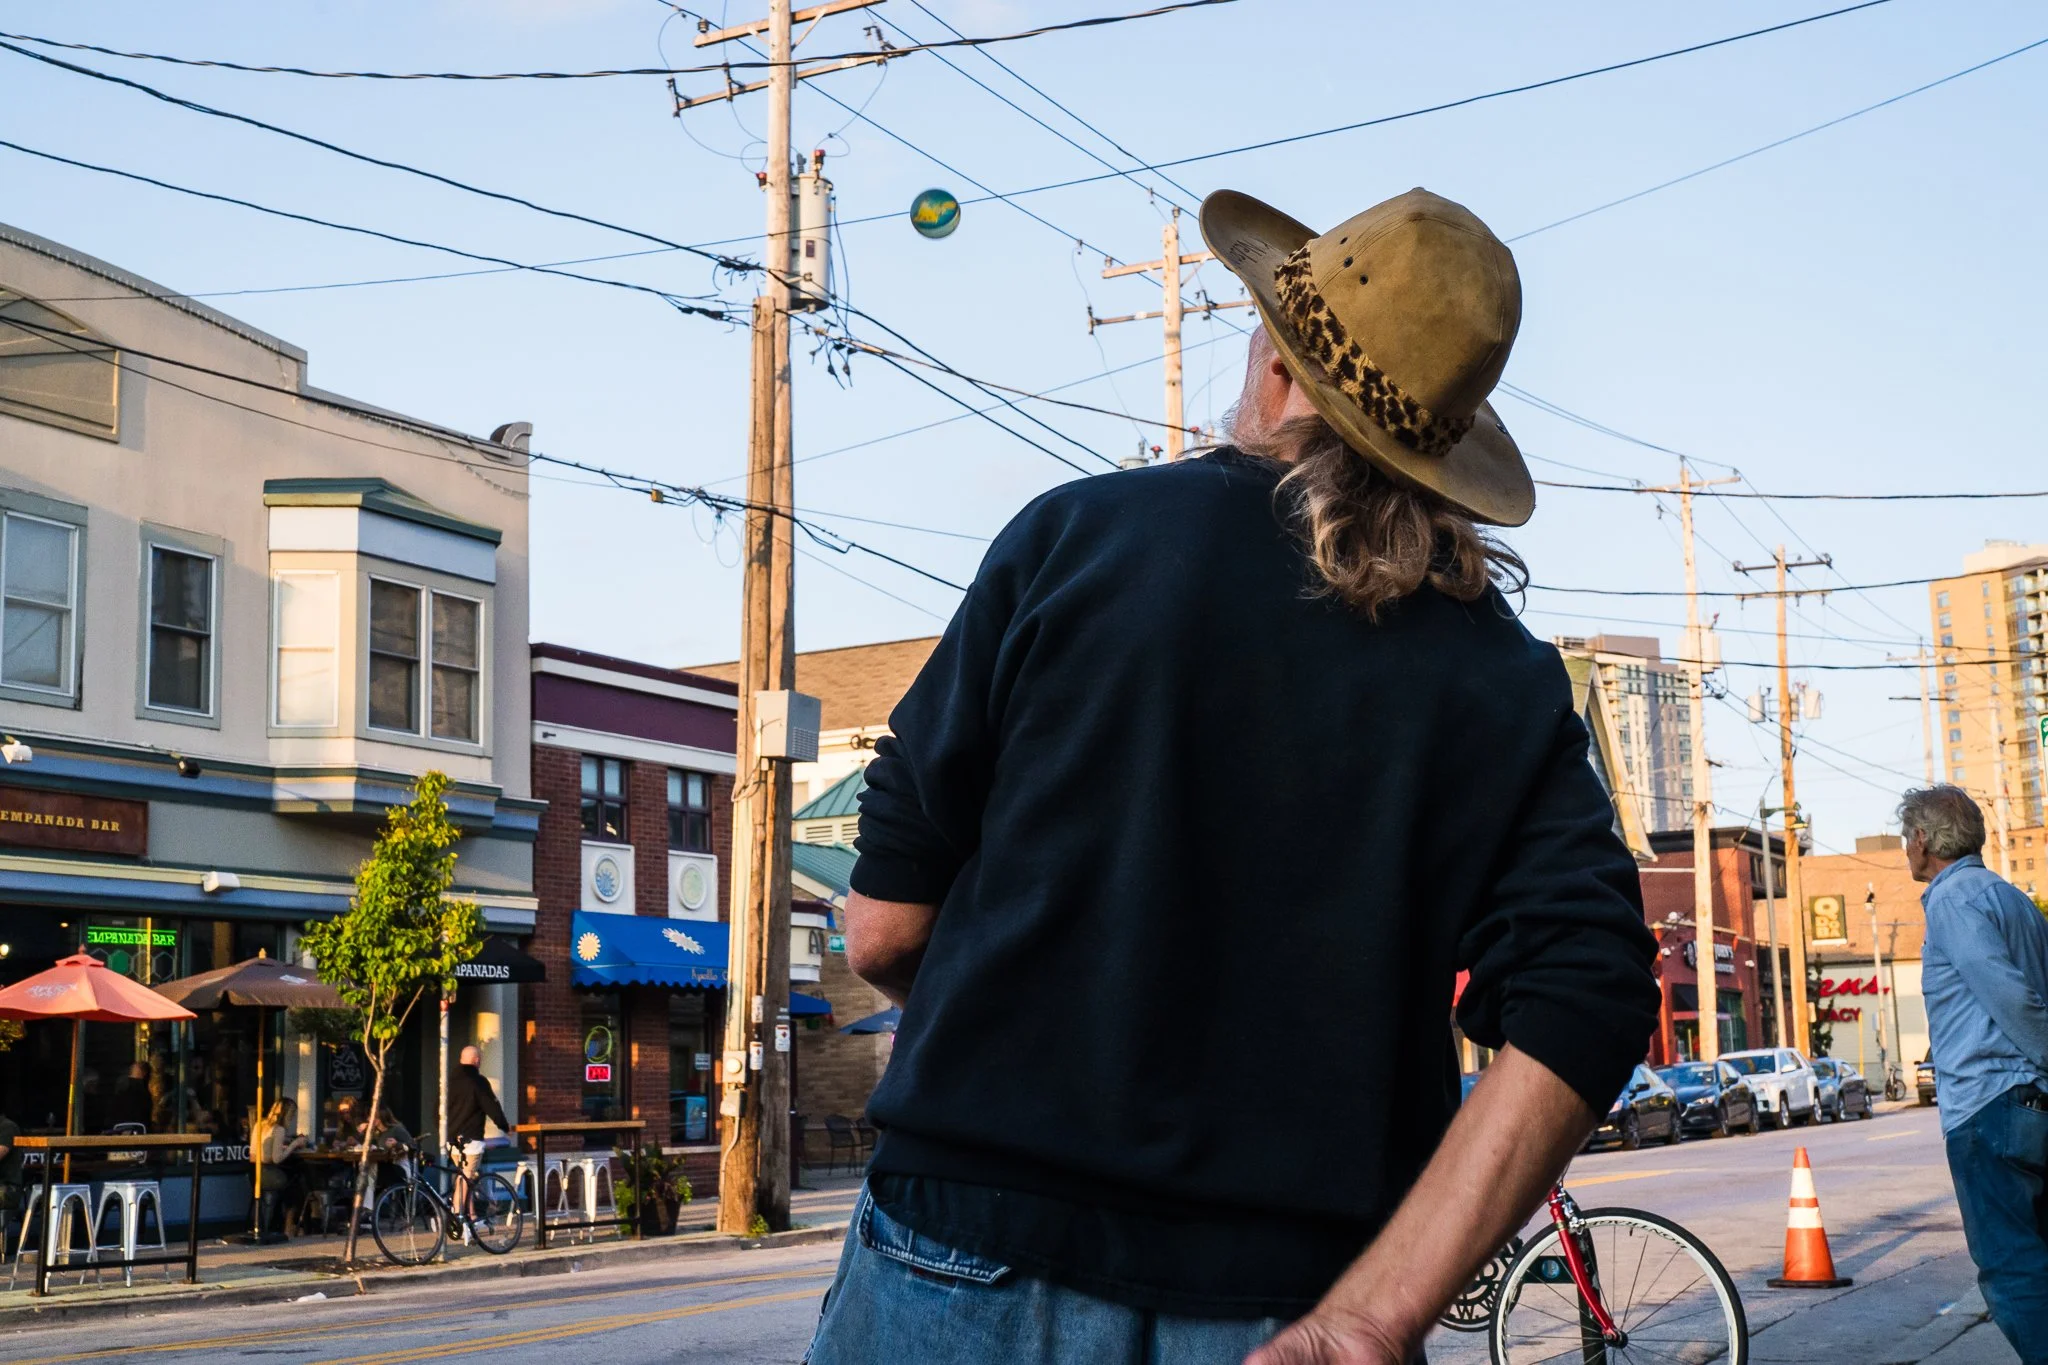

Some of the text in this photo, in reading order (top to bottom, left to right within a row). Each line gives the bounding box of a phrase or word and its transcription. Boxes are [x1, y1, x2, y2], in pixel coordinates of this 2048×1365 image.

[0, 810, 120, 832] EMPANADA BAR
[152, 933, 176, 946] BAR
[455, 963, 510, 979] PANADAS
